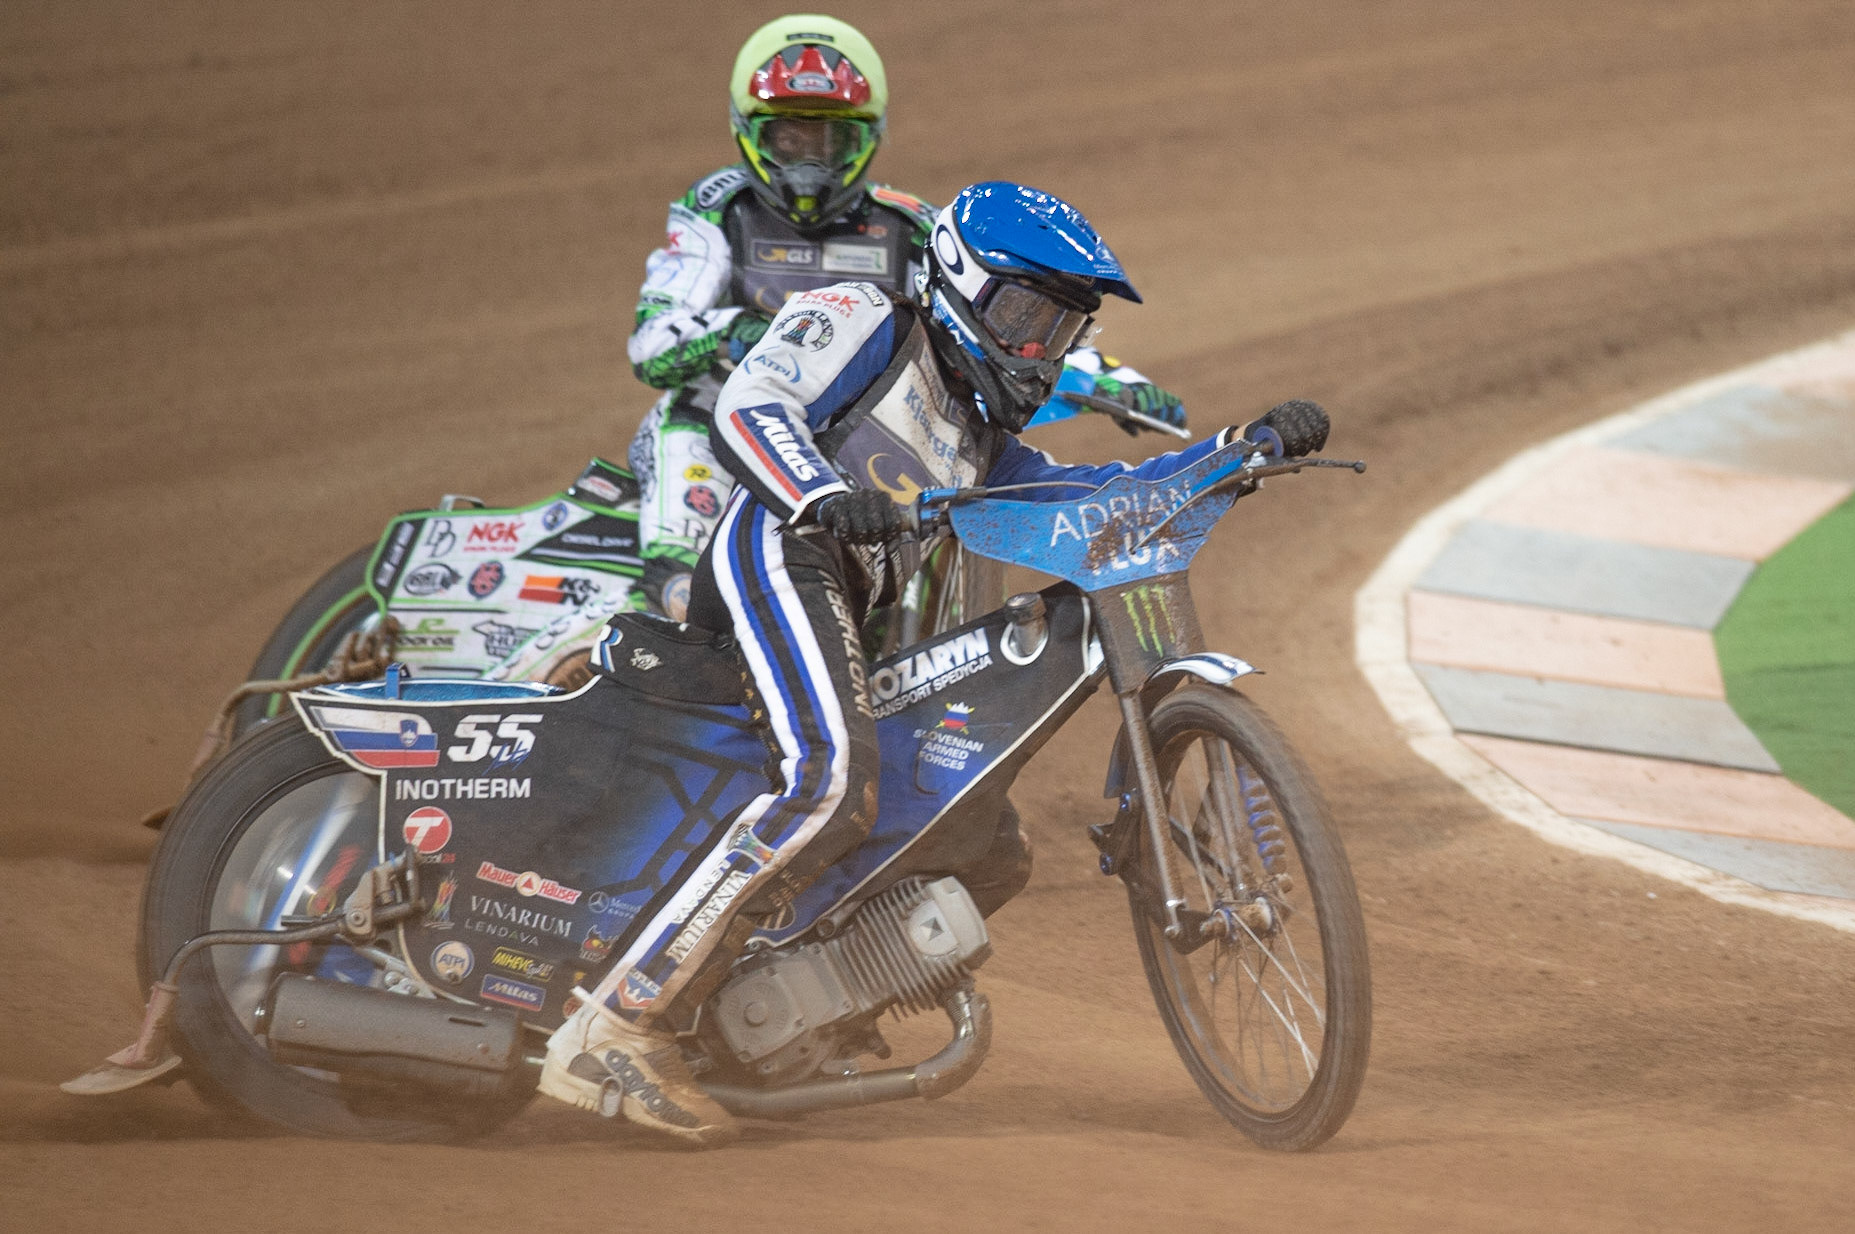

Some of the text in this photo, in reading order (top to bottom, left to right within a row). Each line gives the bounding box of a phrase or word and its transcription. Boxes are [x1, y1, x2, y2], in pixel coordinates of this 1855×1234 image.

[750, 409, 819, 482] Mitas
[467, 522, 525, 543] NGK
[1050, 479, 1192, 547] ADRIAN
[1087, 529, 1180, 576] LUX
[868, 627, 990, 706] OZARYN
[872, 654, 993, 719] RANSPORT SPEDYCJA
[447, 714, 544, 762] 55
[912, 728, 984, 752] SLOVENIAN
[922, 741, 969, 760] ARMED
[918, 750, 966, 771] FORCES
[395, 777, 532, 800] INOTHERM
[478, 862, 579, 903] Mauer Häuser
[464, 918, 539, 947] LENDAVA
[471, 895, 572, 938] VINARIUM
[667, 870, 751, 963] VINARIUM
[488, 982, 538, 1002] Mitas
